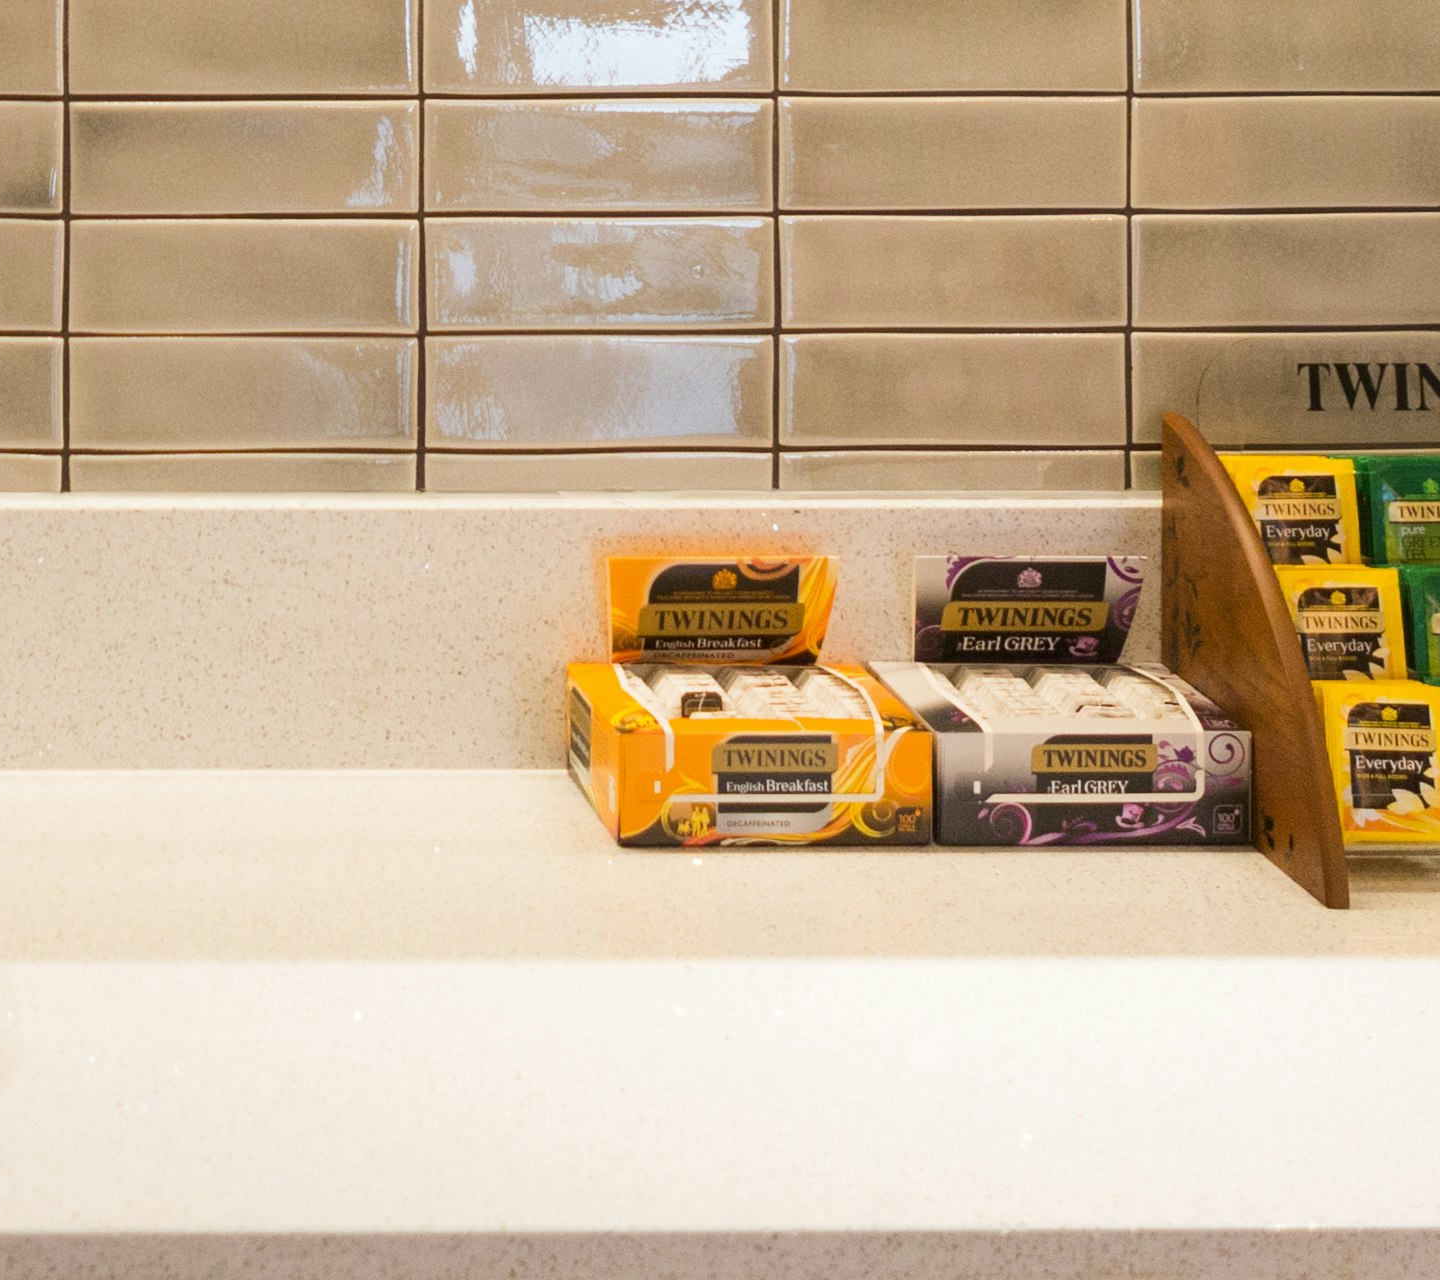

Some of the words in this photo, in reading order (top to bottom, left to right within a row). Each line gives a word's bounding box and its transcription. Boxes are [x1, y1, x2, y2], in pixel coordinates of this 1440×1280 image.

[1262, 503, 1336, 516] TWININGS
[1265, 525, 1331, 540] Everyday
[654, 607, 790, 631] TWININGS
[957, 606, 1093, 628] TWININGS
[1302, 615, 1379, 629] TWININGS
[654, 638, 696, 650] English
[696, 636, 763, 650] Breakfast
[961, 635, 1001, 652] Earl
[1003, 636, 1061, 652] GREY
[1306, 638, 1372, 654] Everyday
[653, 651, 735, 660] DECAFFEINATED
[1352, 731, 1430, 747] TWININGS
[722, 748, 827, 767] TWININGS
[1042, 748, 1147, 768] TWININGS
[1355, 755, 1424, 773] Everyday
[725, 780, 765, 793] English
[766, 778, 829, 793] Breakfast
[1050, 779, 1082, 794] Earl
[1084, 780, 1129, 794] GREY
[726, 819, 791, 828] DECAFFEINATED
